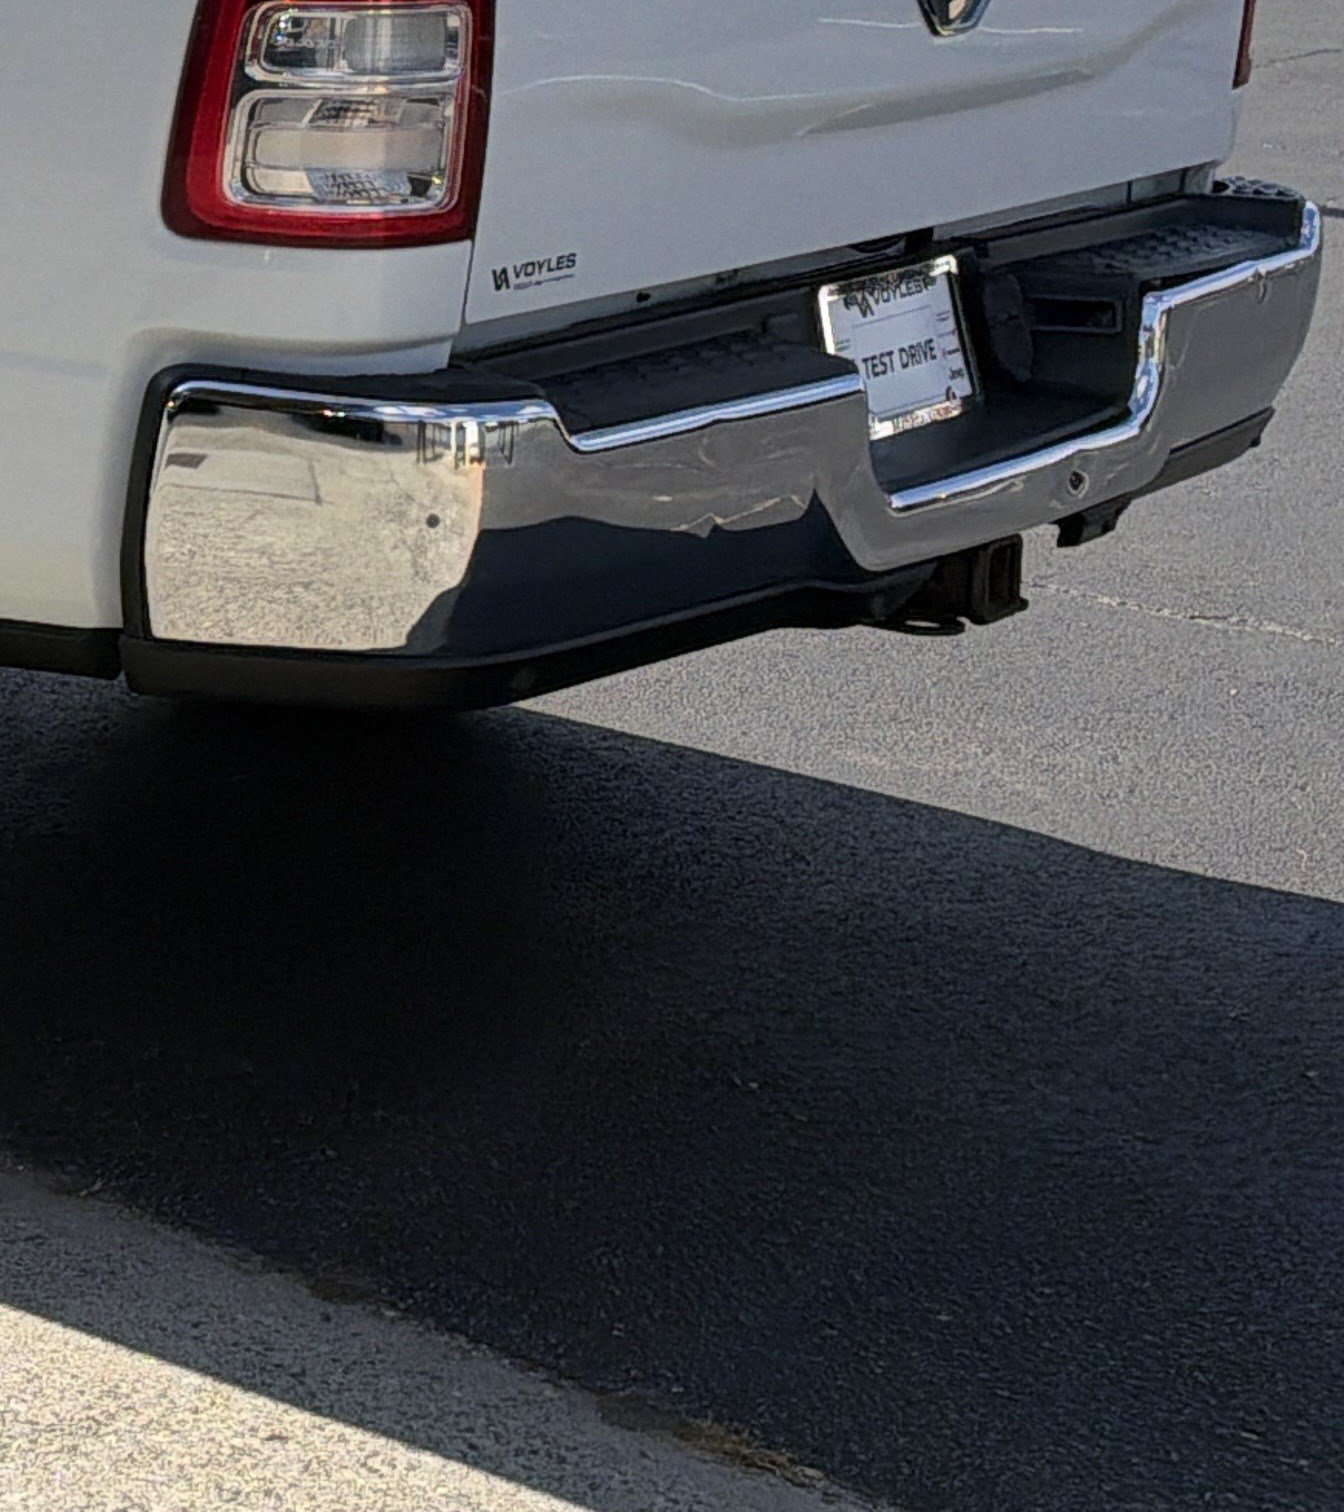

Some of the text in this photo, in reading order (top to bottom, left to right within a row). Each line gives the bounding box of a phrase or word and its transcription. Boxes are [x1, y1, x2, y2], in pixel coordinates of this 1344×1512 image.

[513, 252, 577, 279] VOYLES
[862, 338, 938, 380] TEST DRIVE
